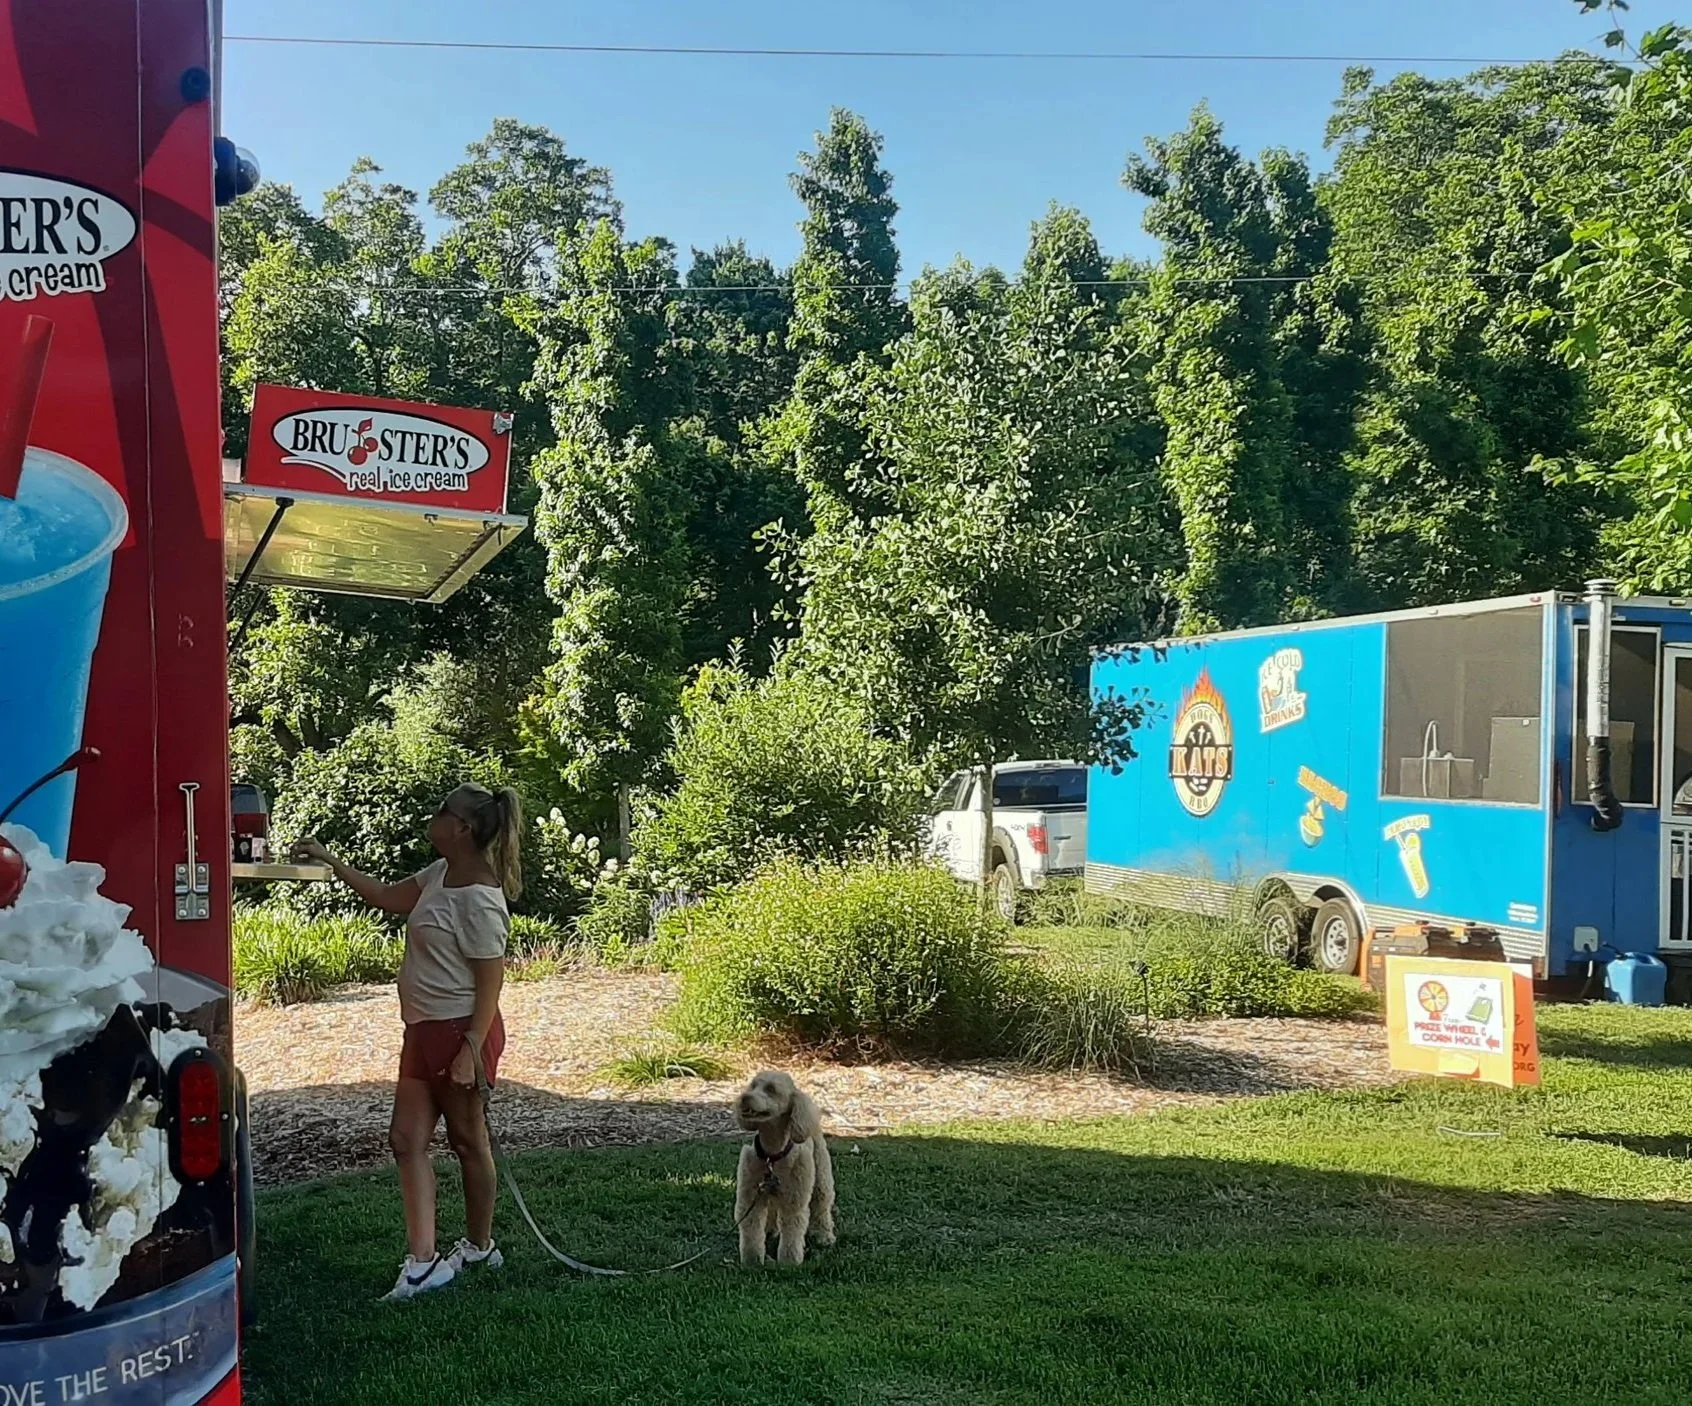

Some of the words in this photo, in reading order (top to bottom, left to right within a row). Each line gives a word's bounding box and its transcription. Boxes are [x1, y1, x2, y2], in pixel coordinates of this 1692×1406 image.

[8, 262, 102, 297] cream
[349, 466, 381, 489] real
[388, 468, 411, 489] ice
[414, 471, 466, 489] cream
[1264, 702, 1302, 728] DRINKS
[1172, 746, 1229, 778] KATS
[1414, 1021, 1441, 1033] PRIZE
[1444, 1023, 1479, 1036] WHEEL
[1422, 1032, 1452, 1044] CORN
[1455, 1034, 1481, 1047] HOLE
[55, 1366, 108, 1401] THE
